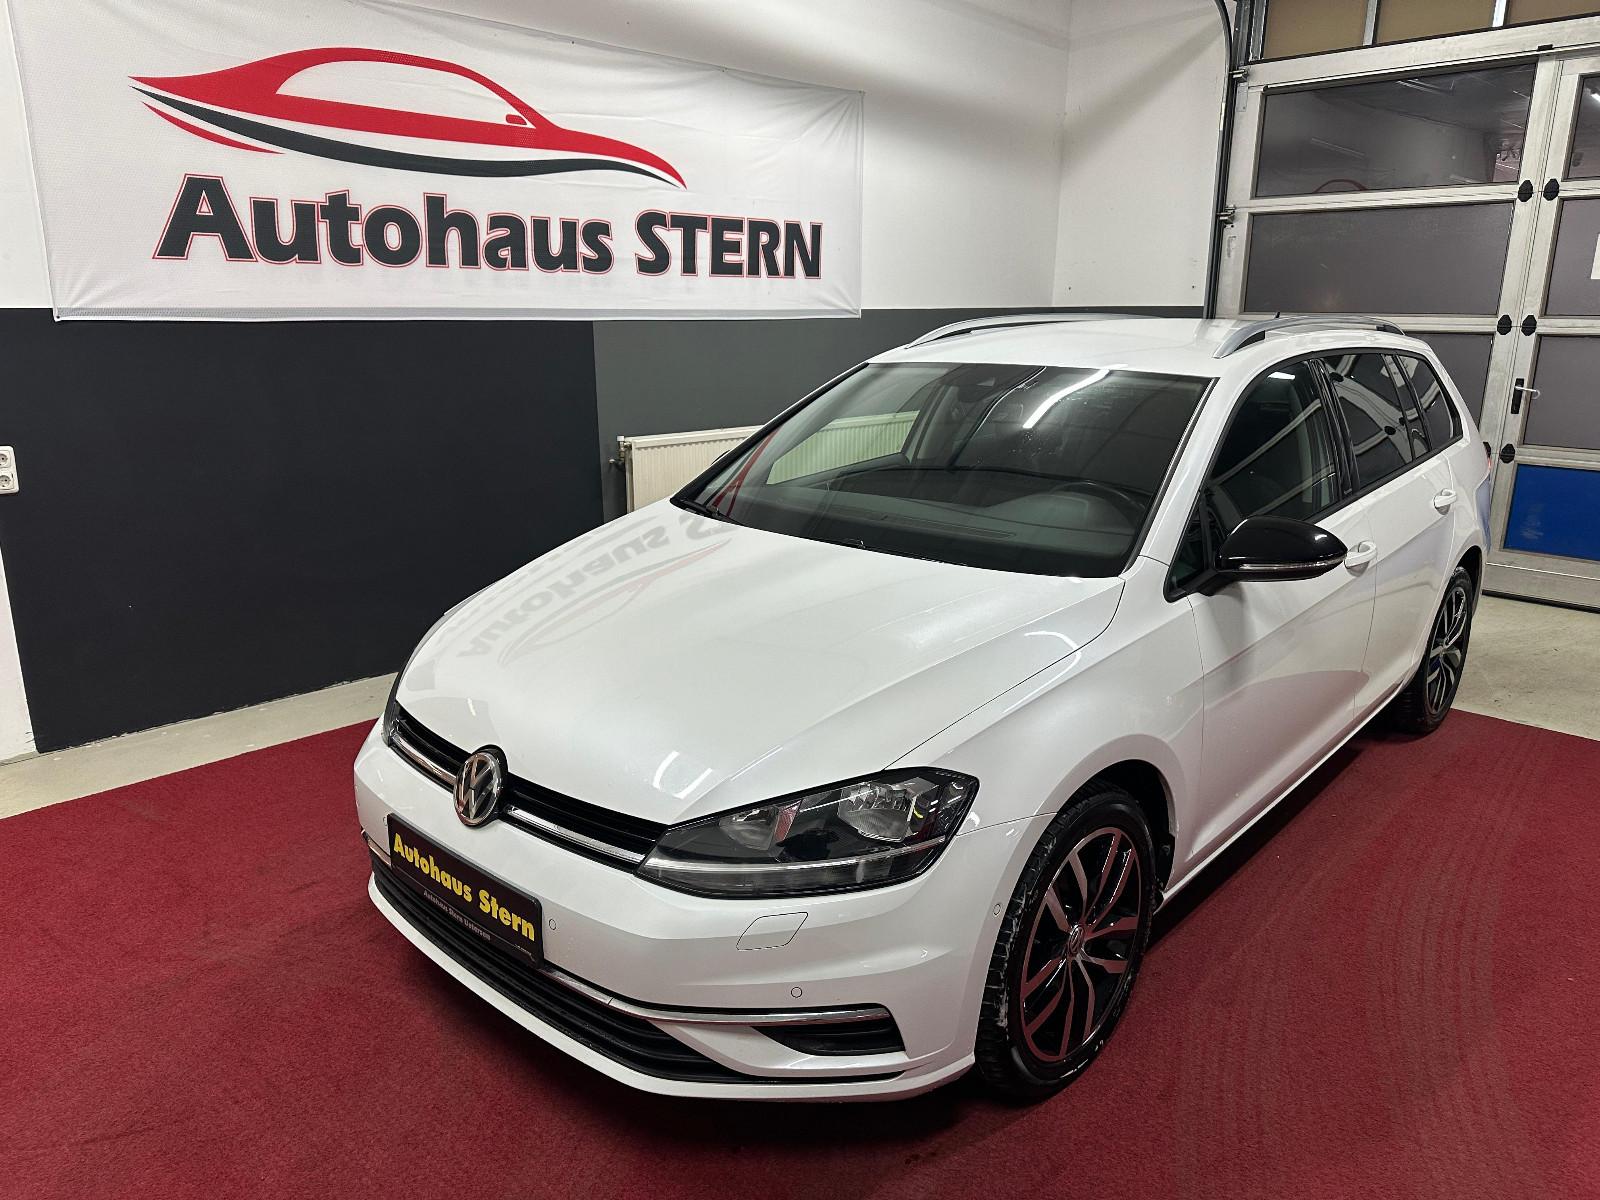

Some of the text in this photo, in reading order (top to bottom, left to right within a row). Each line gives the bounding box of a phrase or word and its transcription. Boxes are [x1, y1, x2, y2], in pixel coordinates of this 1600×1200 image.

[153, 173, 823, 280] Autohaus STERN
[455, 752, 500, 824] VW
[393, 832, 535, 942] Autohaus Stern
